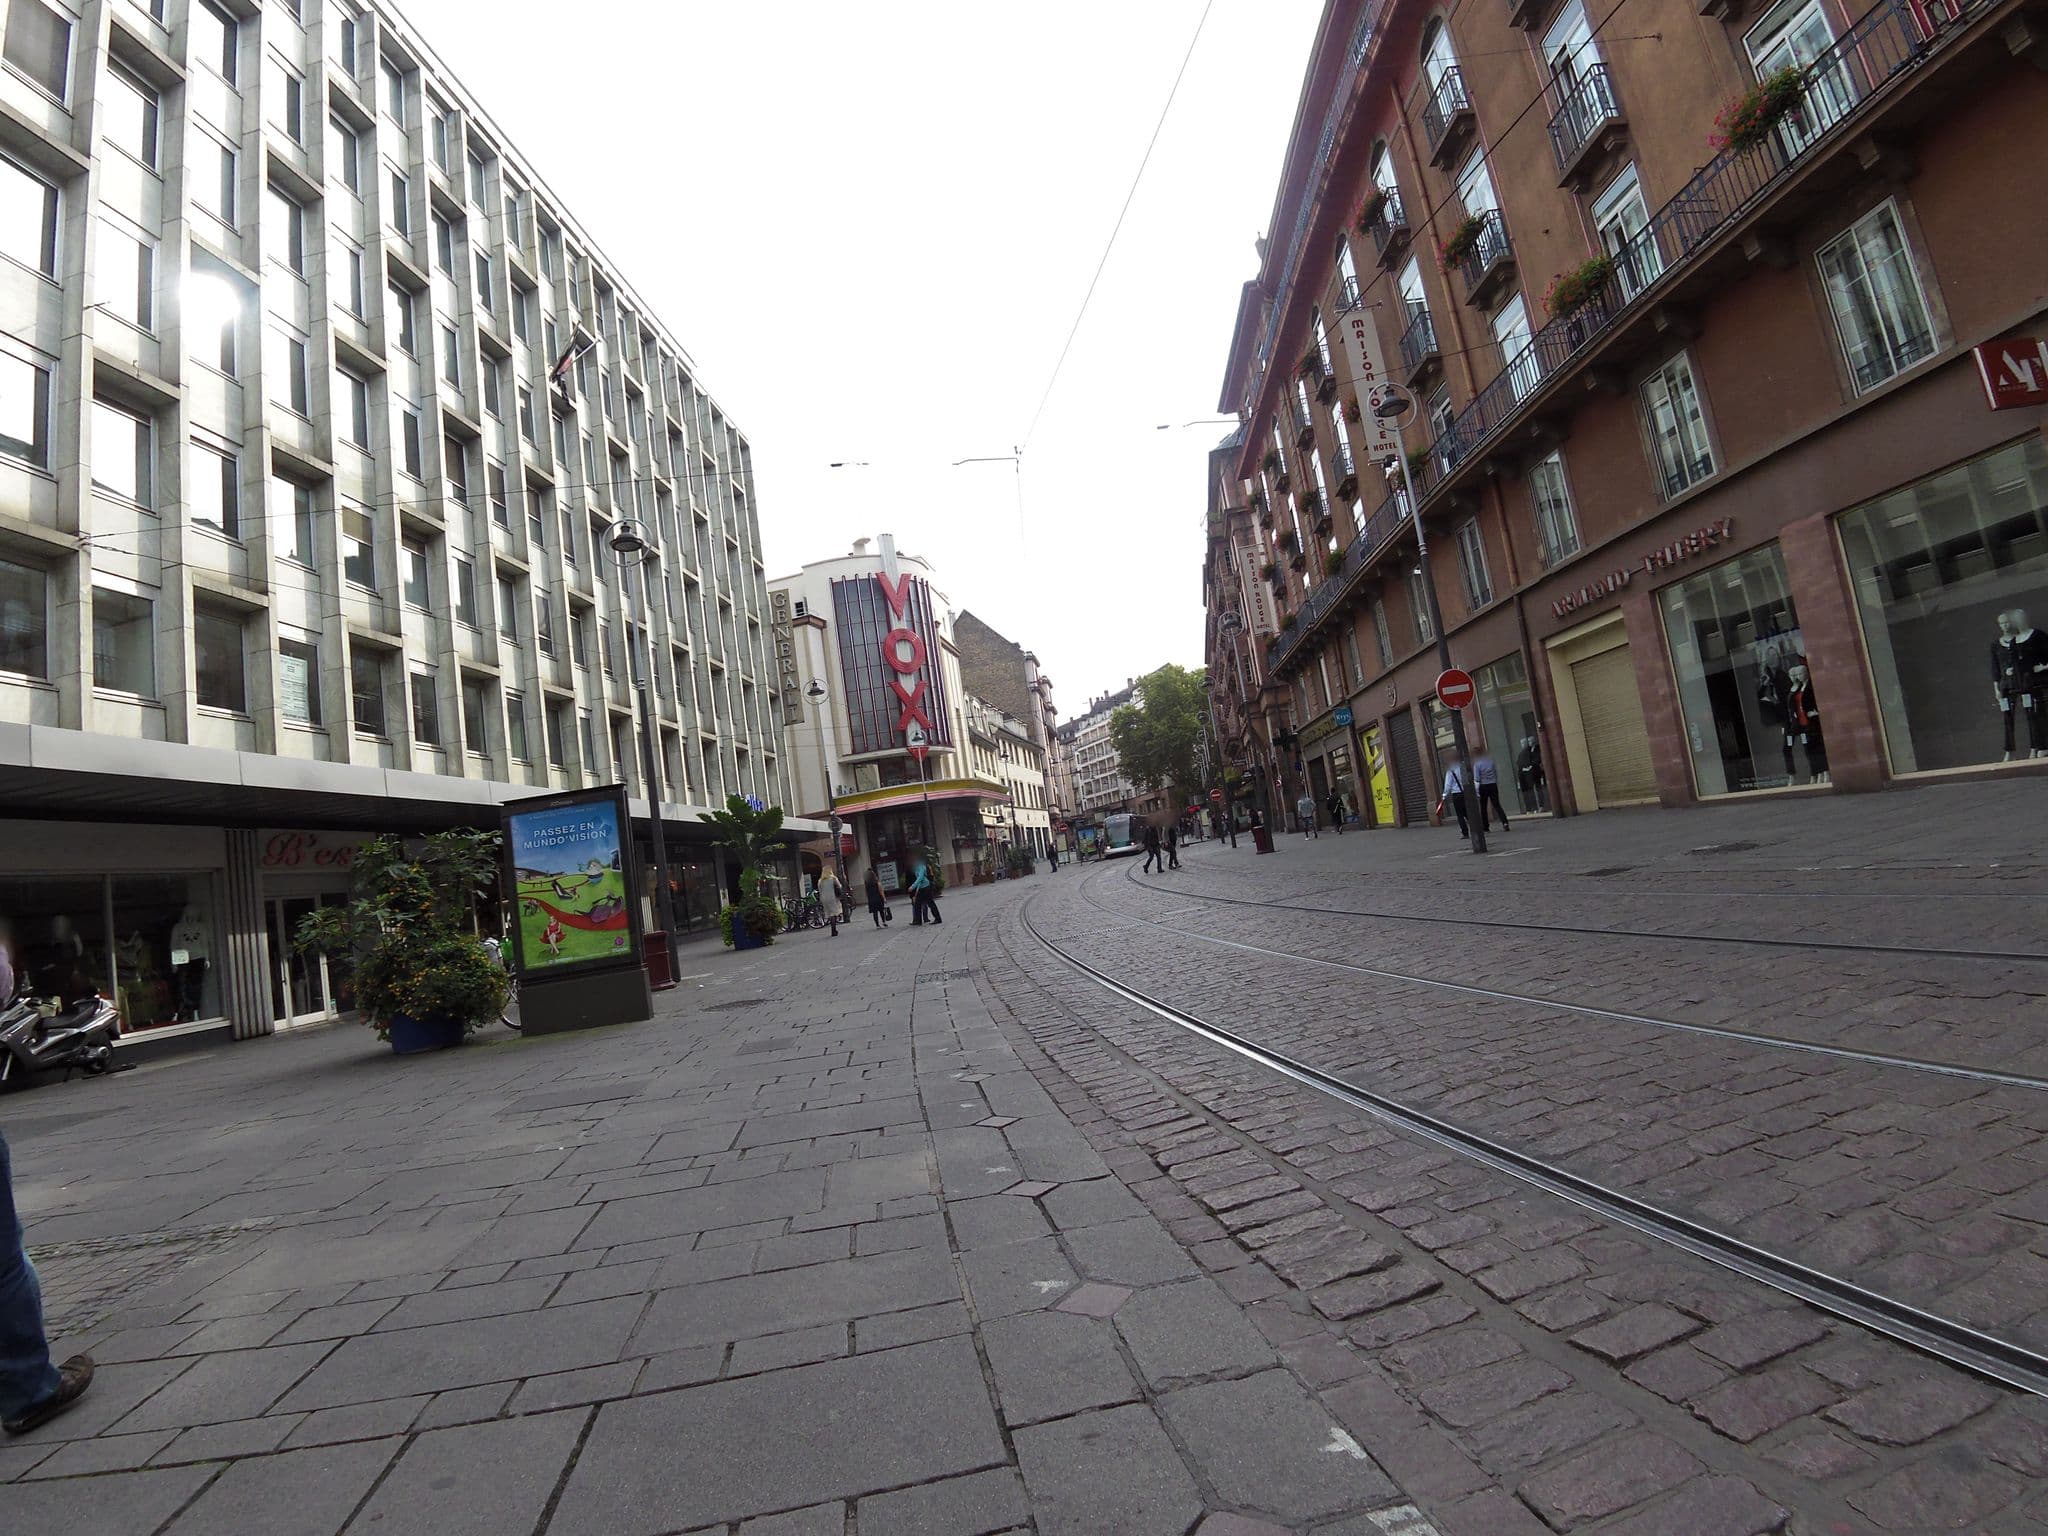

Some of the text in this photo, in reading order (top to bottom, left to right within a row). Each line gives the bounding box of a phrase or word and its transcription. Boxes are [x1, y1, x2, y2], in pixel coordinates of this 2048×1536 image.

[1351, 319, 1387, 440] MAISON ROGE
[1373, 441, 1398, 453] HOTEL
[1552, 515, 1735, 619] ARMAND THIERY
[875, 571, 934, 731] VOX
[523, 829, 608, 850] MUNDO'VISION
[533, 821, 595, 838] PASSEZ EN
